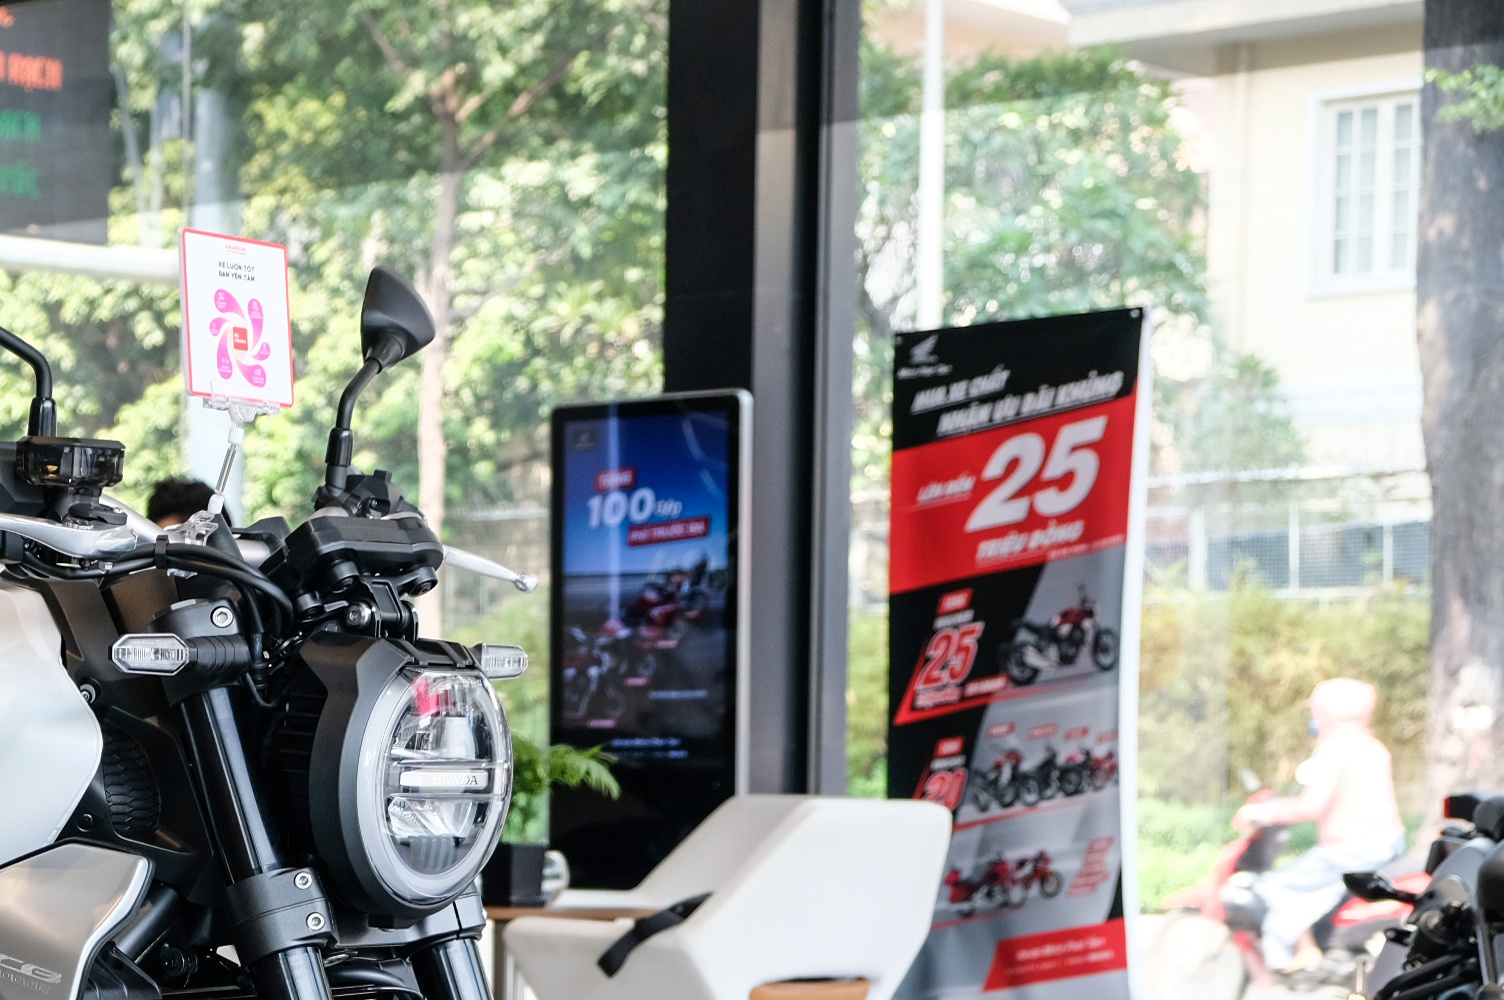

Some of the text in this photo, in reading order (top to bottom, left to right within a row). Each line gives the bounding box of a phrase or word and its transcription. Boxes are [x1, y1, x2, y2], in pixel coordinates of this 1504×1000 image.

[965, 415, 1109, 533] 25
[914, 621, 986, 691] 25
[431, 774, 479, 786] HONDA
